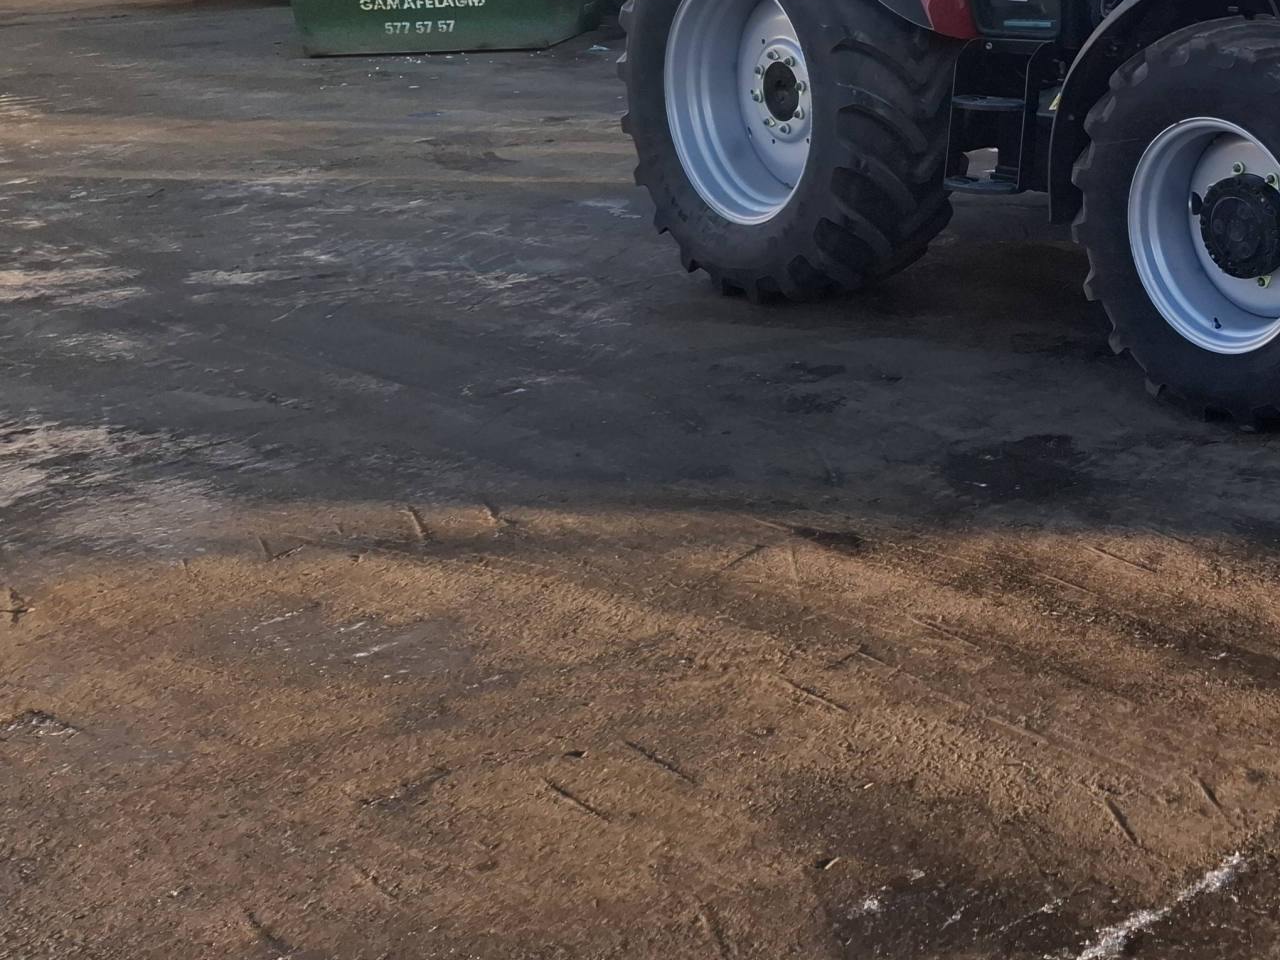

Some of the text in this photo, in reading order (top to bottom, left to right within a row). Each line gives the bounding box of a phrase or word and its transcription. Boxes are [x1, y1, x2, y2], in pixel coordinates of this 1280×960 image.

[385, 20, 456, 34] 577 57 57
